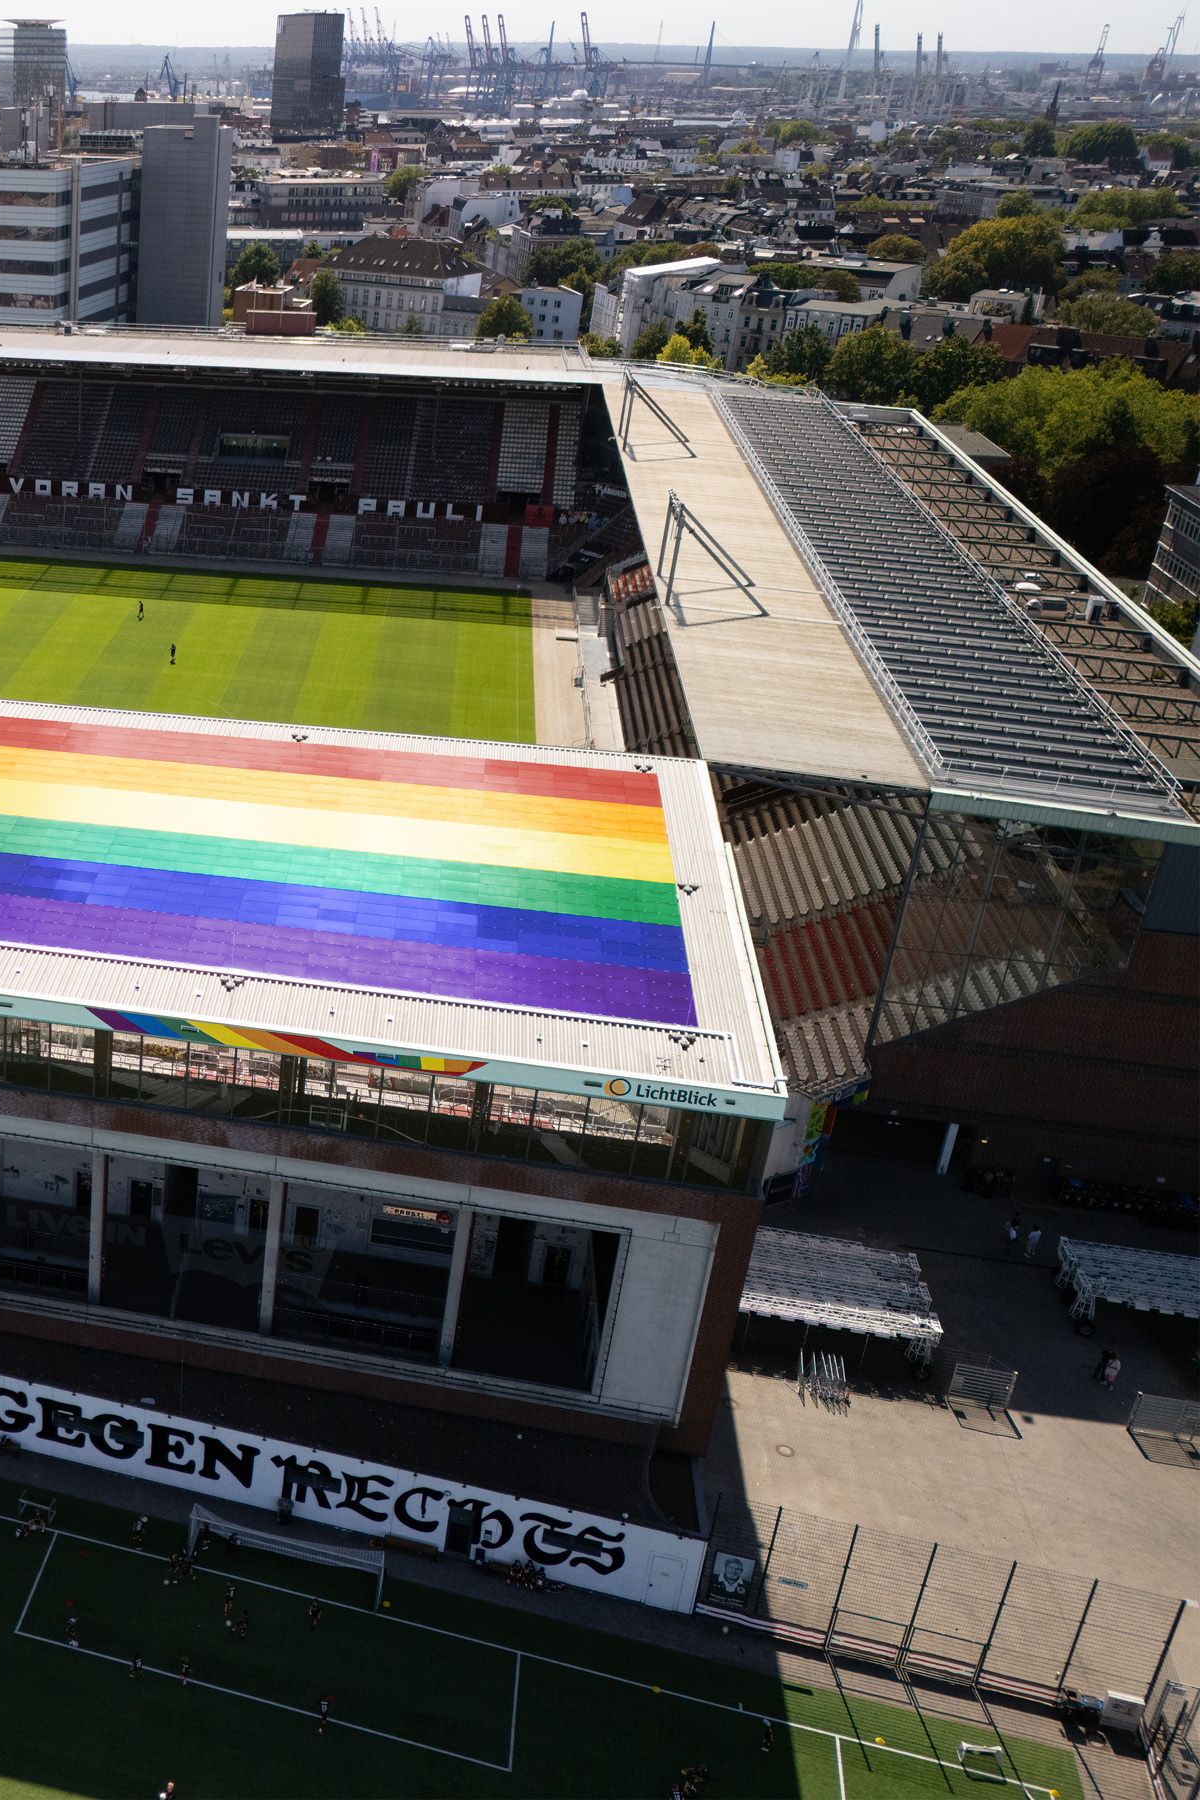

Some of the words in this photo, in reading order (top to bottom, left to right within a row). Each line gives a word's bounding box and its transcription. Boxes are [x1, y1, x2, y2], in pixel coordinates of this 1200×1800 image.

[8, 478, 133, 500] VORAN
[176, 487, 307, 512] SANKT
[357, 498, 484, 522] PAULI
[635, 1084, 718, 1107] LichtBlick
[270, 1455, 625, 1575] RECHTS
